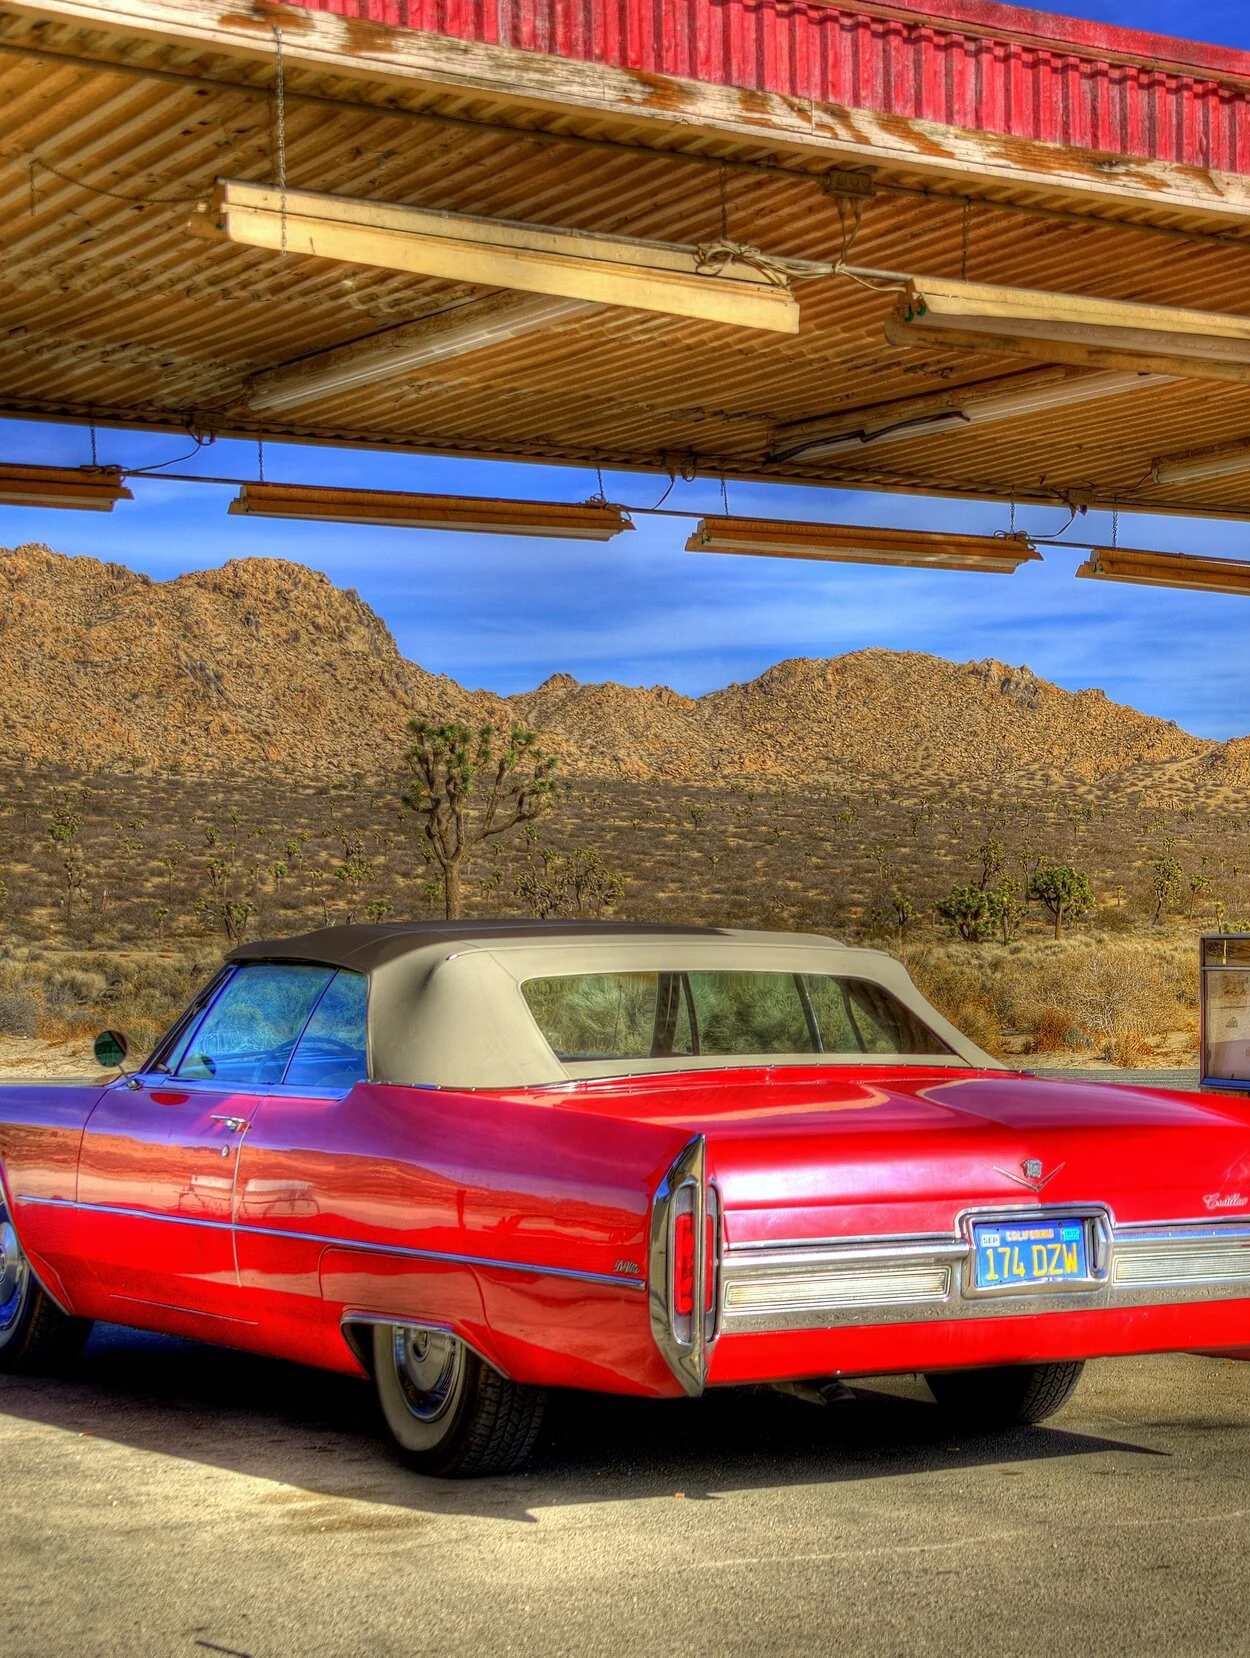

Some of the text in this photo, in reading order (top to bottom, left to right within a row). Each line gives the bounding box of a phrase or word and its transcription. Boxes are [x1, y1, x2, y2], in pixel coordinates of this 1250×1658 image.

[1202, 1192, 1249, 1210] Cadillac
[983, 1236, 998, 1244] SEP
[1006, 1229, 1054, 1241] CALIFORNIA
[986, 1243, 1078, 1280] 174 DZW
